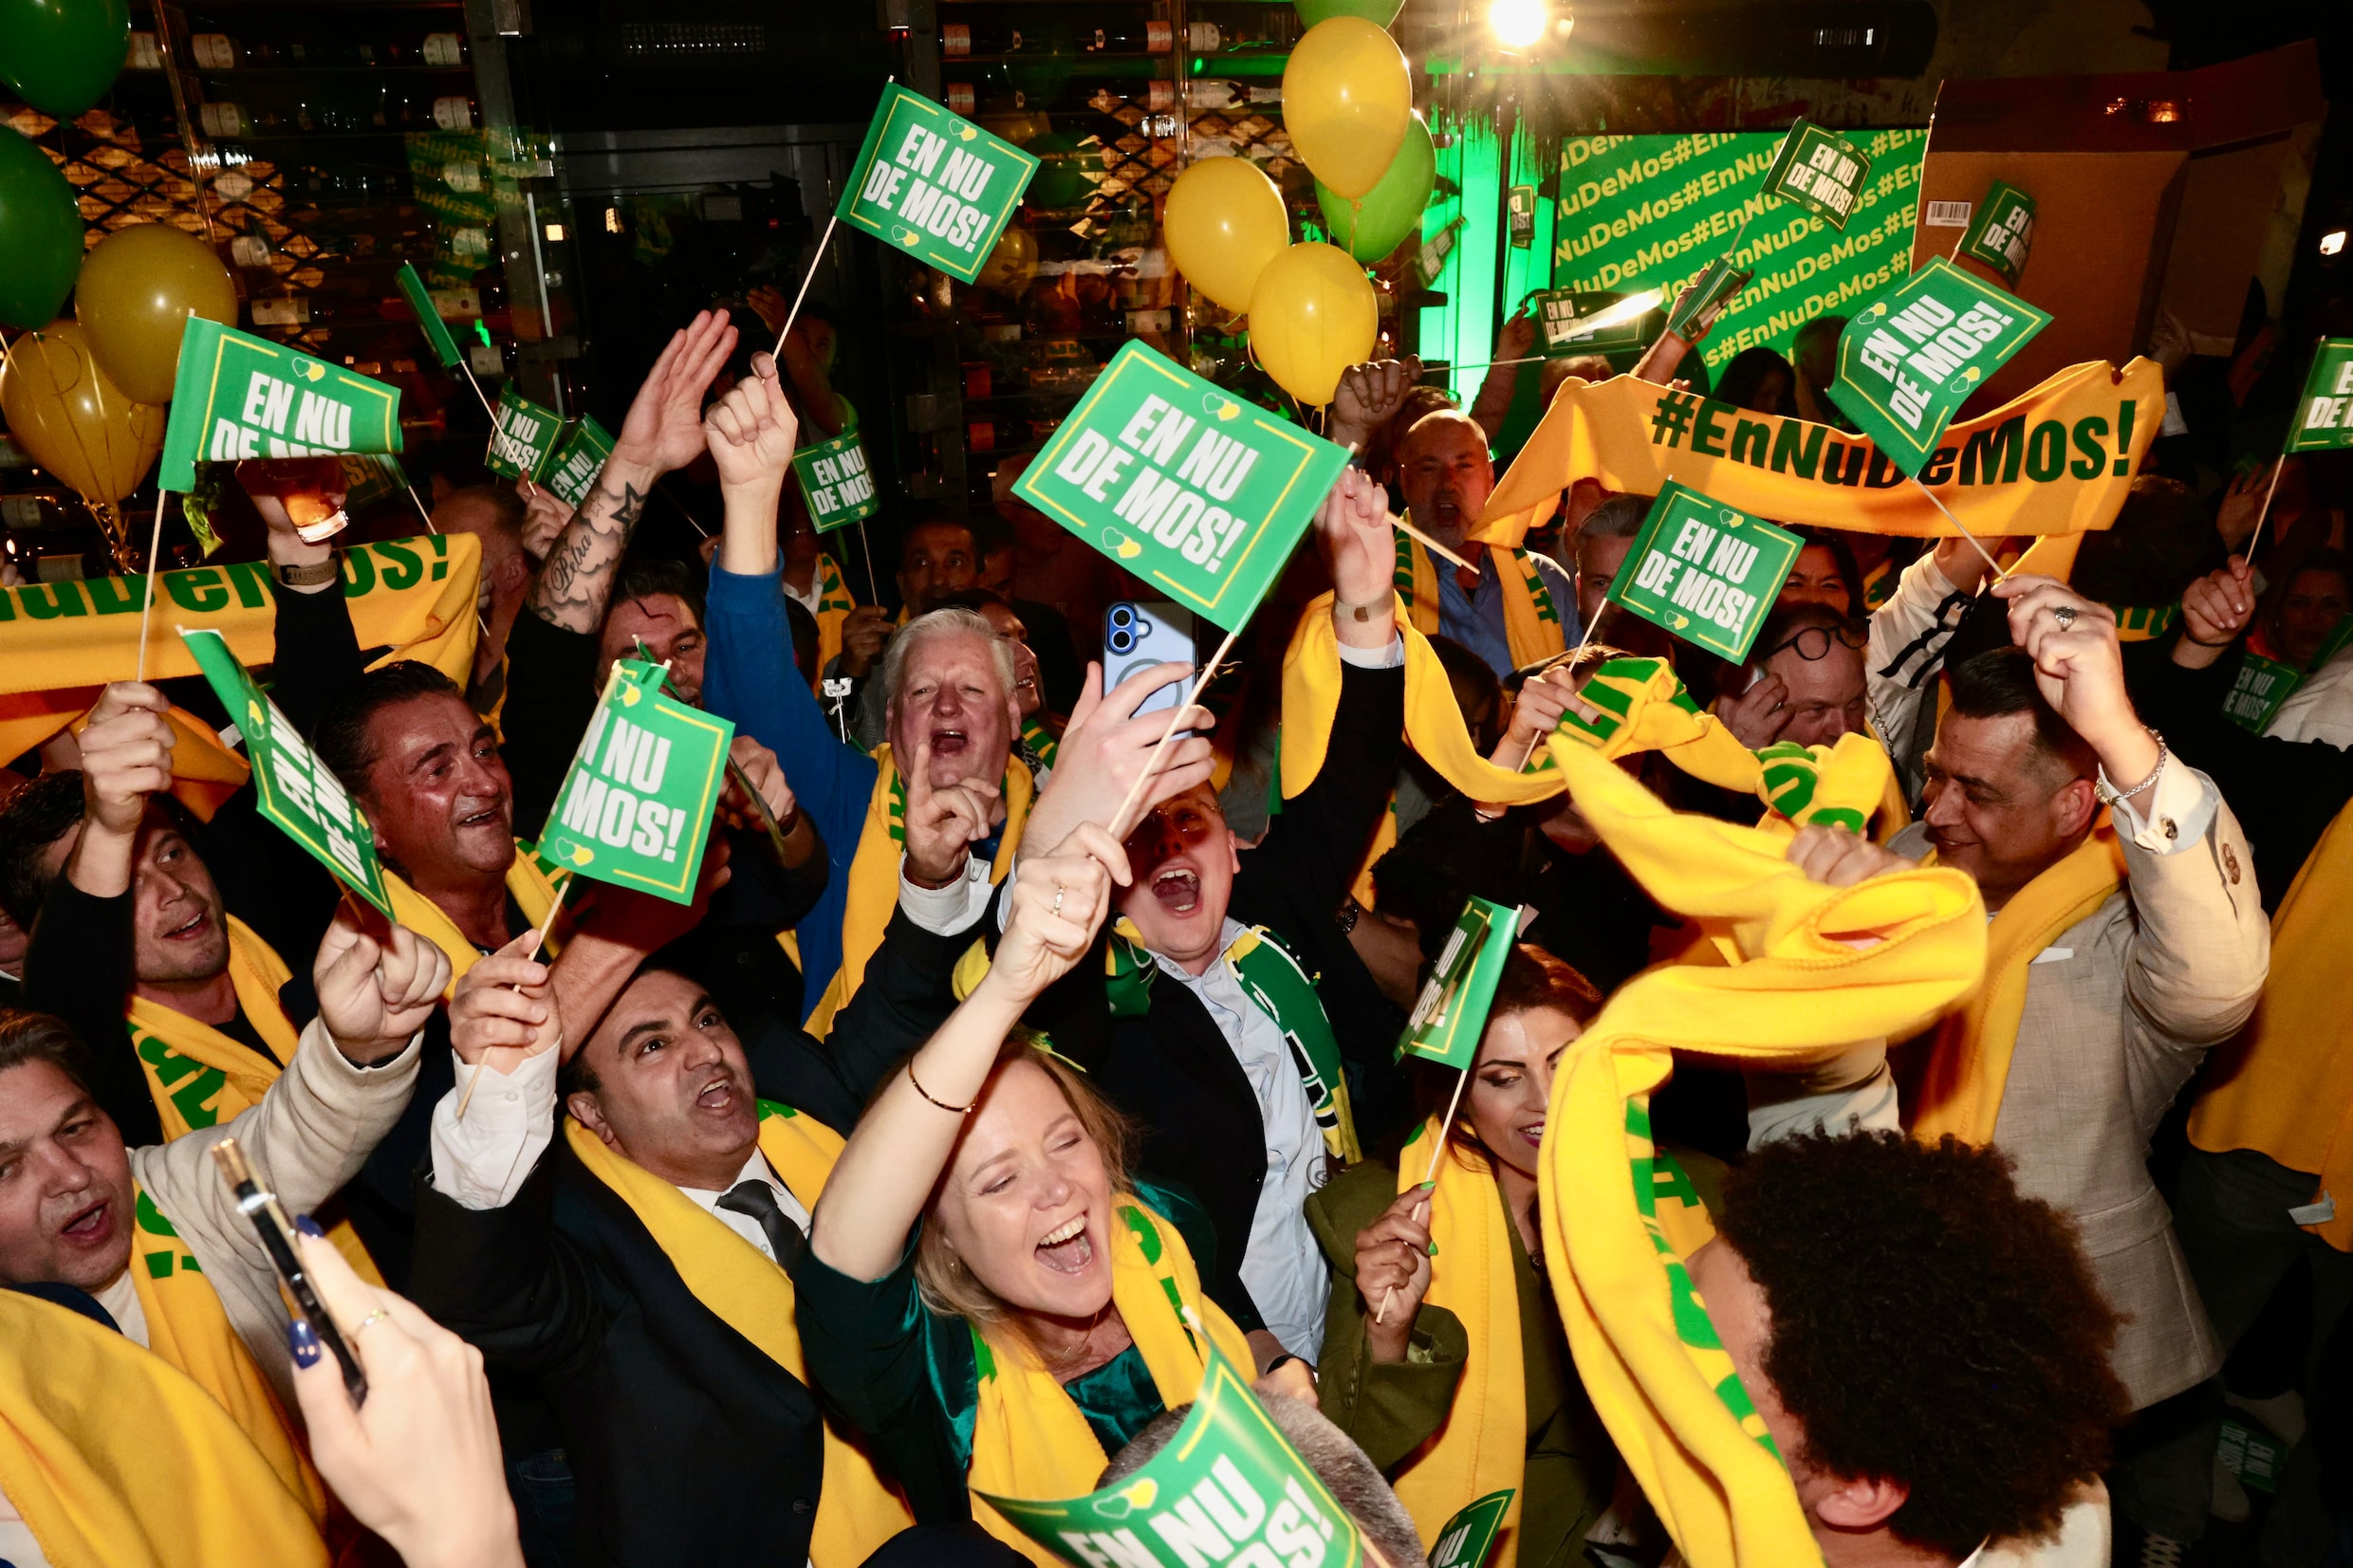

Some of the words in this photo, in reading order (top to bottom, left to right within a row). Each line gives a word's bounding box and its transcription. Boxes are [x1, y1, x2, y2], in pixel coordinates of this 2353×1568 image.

[896, 123, 948, 178] EN
[937, 146, 995, 202] NU
[1786, 162, 1815, 193] DE
[1809, 172, 1855, 217] MOS!
[1808, 143, 1839, 175] EN
[1832, 156, 1859, 188] NU
[862, 159, 908, 211] DE
[898, 177, 991, 253] MOS!
[1983, 223, 2010, 252] DE
[2005, 206, 2029, 234] EN
[1860, 327, 1911, 383] EN
[1888, 294, 1955, 344] NU
[1906, 301, 2013, 385] MOS!
[242, 371, 295, 434] EN
[295, 390, 352, 450] NU
[509, 412, 541, 443] NU
[1889, 370, 1933, 431] DE
[2306, 397, 2348, 429] DE
[551, 469, 576, 500] EN
[566, 449, 594, 481] NU
[811, 457, 842, 487] EN
[837, 445, 866, 478] NU
[1118, 393, 1197, 468] EN
[1176, 427, 1260, 502] NU
[811, 487, 842, 515] DE
[1054, 427, 1135, 504] DE
[1112, 465, 1248, 574] MOS!
[1671, 518, 1717, 565] EN
[1707, 534, 1760, 584] NU
[1635, 549, 1682, 598] DE
[1671, 566, 1757, 635] MOS!
[271, 747, 322, 825] EN
[601, 716, 672, 794] NU
[327, 812, 369, 886] DE
[561, 766, 686, 863] MOS!
[1148, 1453, 1267, 1568] NU
